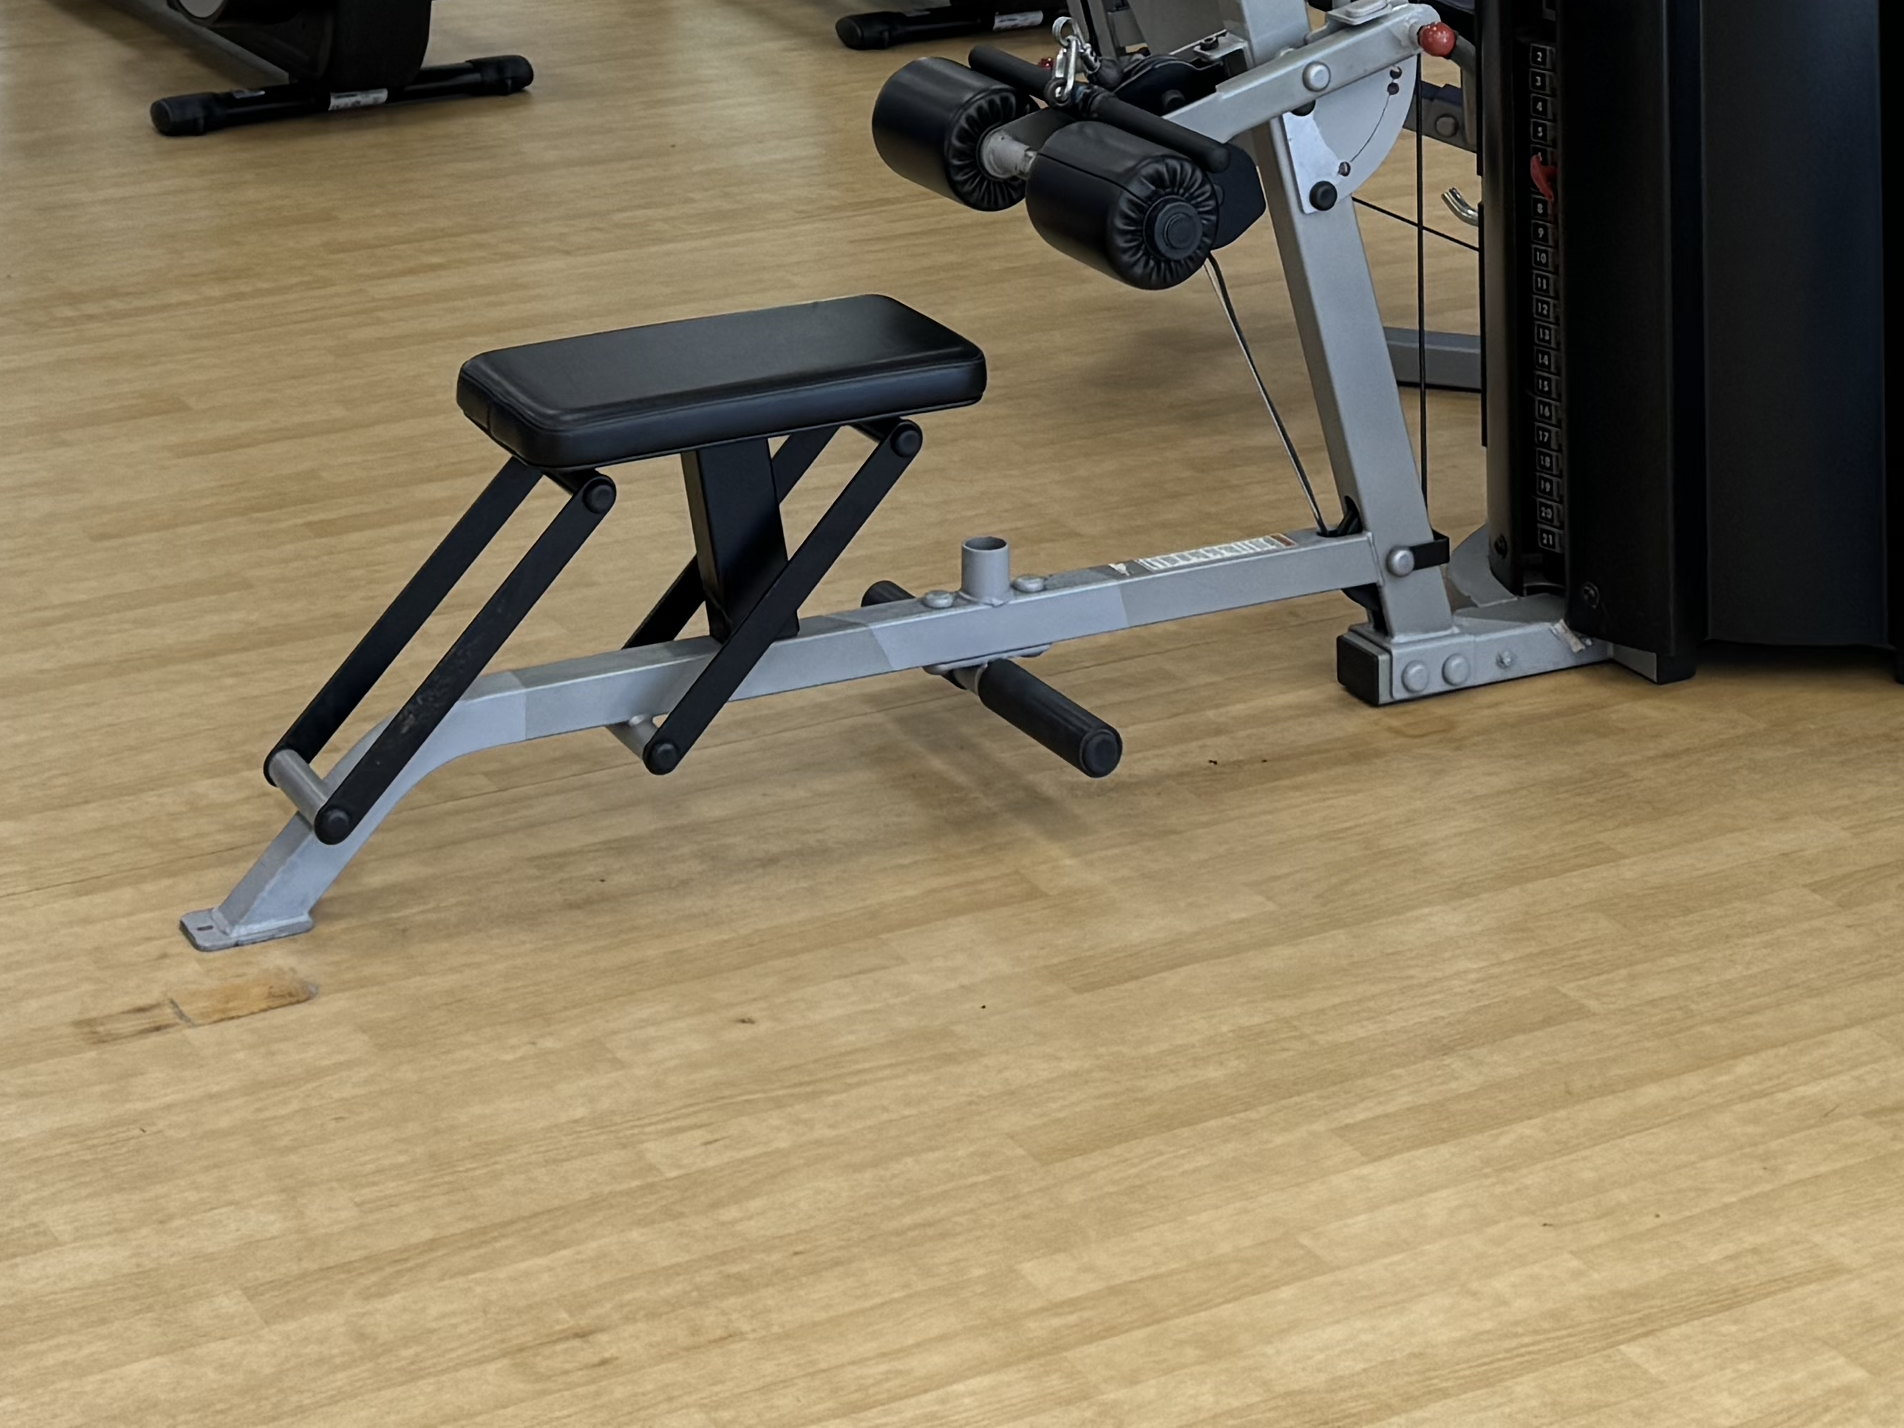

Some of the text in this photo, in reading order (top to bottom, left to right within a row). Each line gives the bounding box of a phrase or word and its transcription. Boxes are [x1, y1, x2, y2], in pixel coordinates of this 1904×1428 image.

[1536, 52, 1542, 62] 2
[1535, 75, 1541, 86] 3
[1536, 101, 1543, 112] 4
[1537, 126, 1543, 137] 5
[1537, 203, 1543, 214] 8
[1537, 228, 1544, 239] 9
[1536, 251, 1546, 264] 10
[1536, 277, 1546, 290] 11
[1537, 302, 1548, 315] 12
[1539, 328, 1550, 341] 13
[1538, 353, 1549, 366] 14
[1538, 379, 1549, 392] 15
[1539, 404, 1550, 418] 16
[1538, 430, 1550, 443] 17
[1540, 455, 1551, 468] 18
[1540, 480, 1551, 493] 19
[1540, 506, 1552, 520] 20
[1541, 533, 1553, 546] 21
